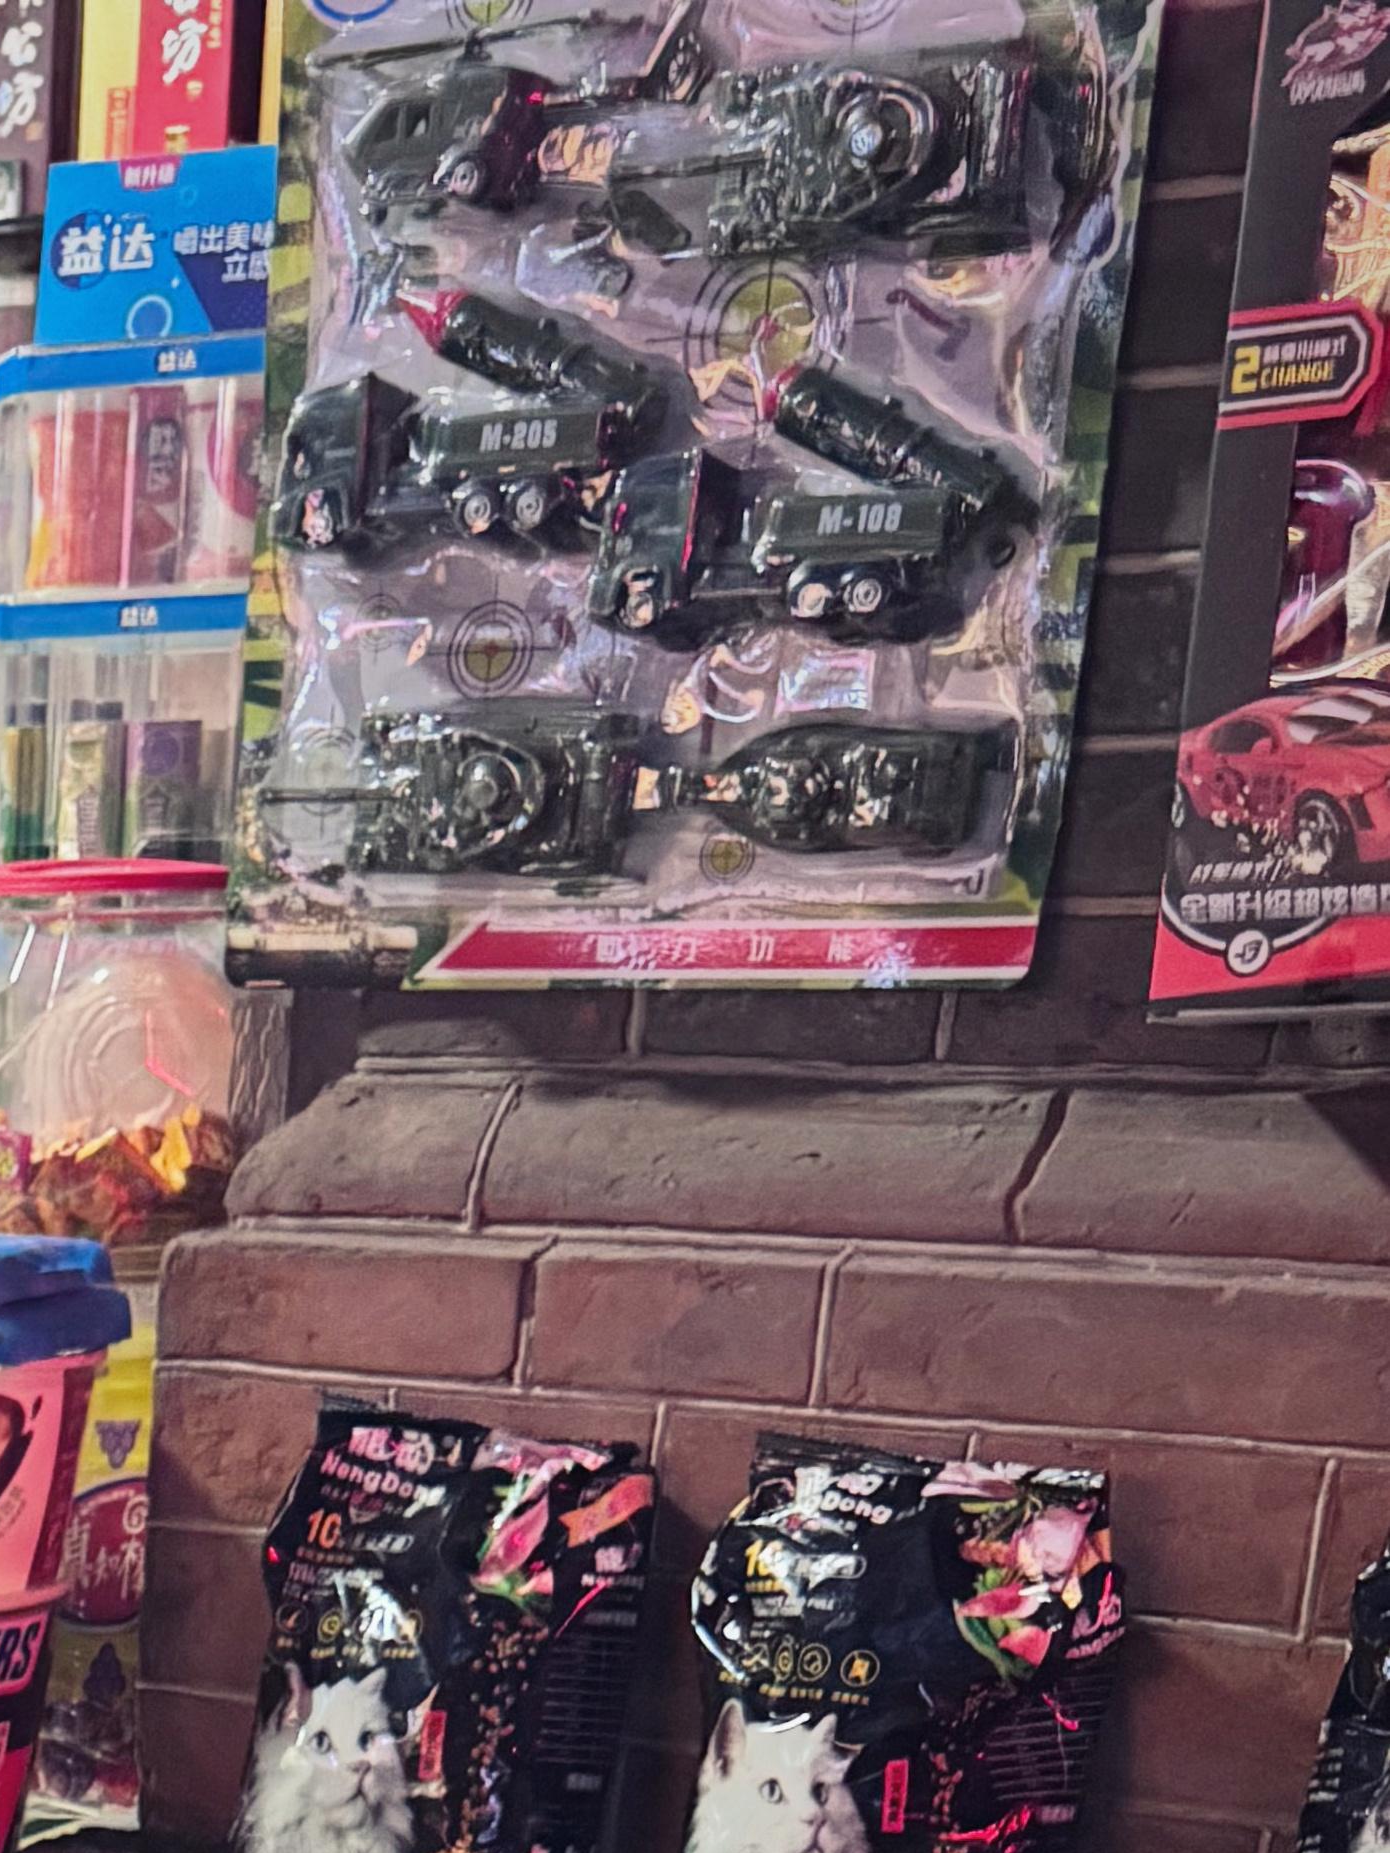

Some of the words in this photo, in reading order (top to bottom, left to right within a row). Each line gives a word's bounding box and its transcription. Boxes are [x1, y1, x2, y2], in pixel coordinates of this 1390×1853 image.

[58, 214, 155, 277] 益达
[1231, 345, 1260, 394] 2
[817, 504, 903, 534] M-108
